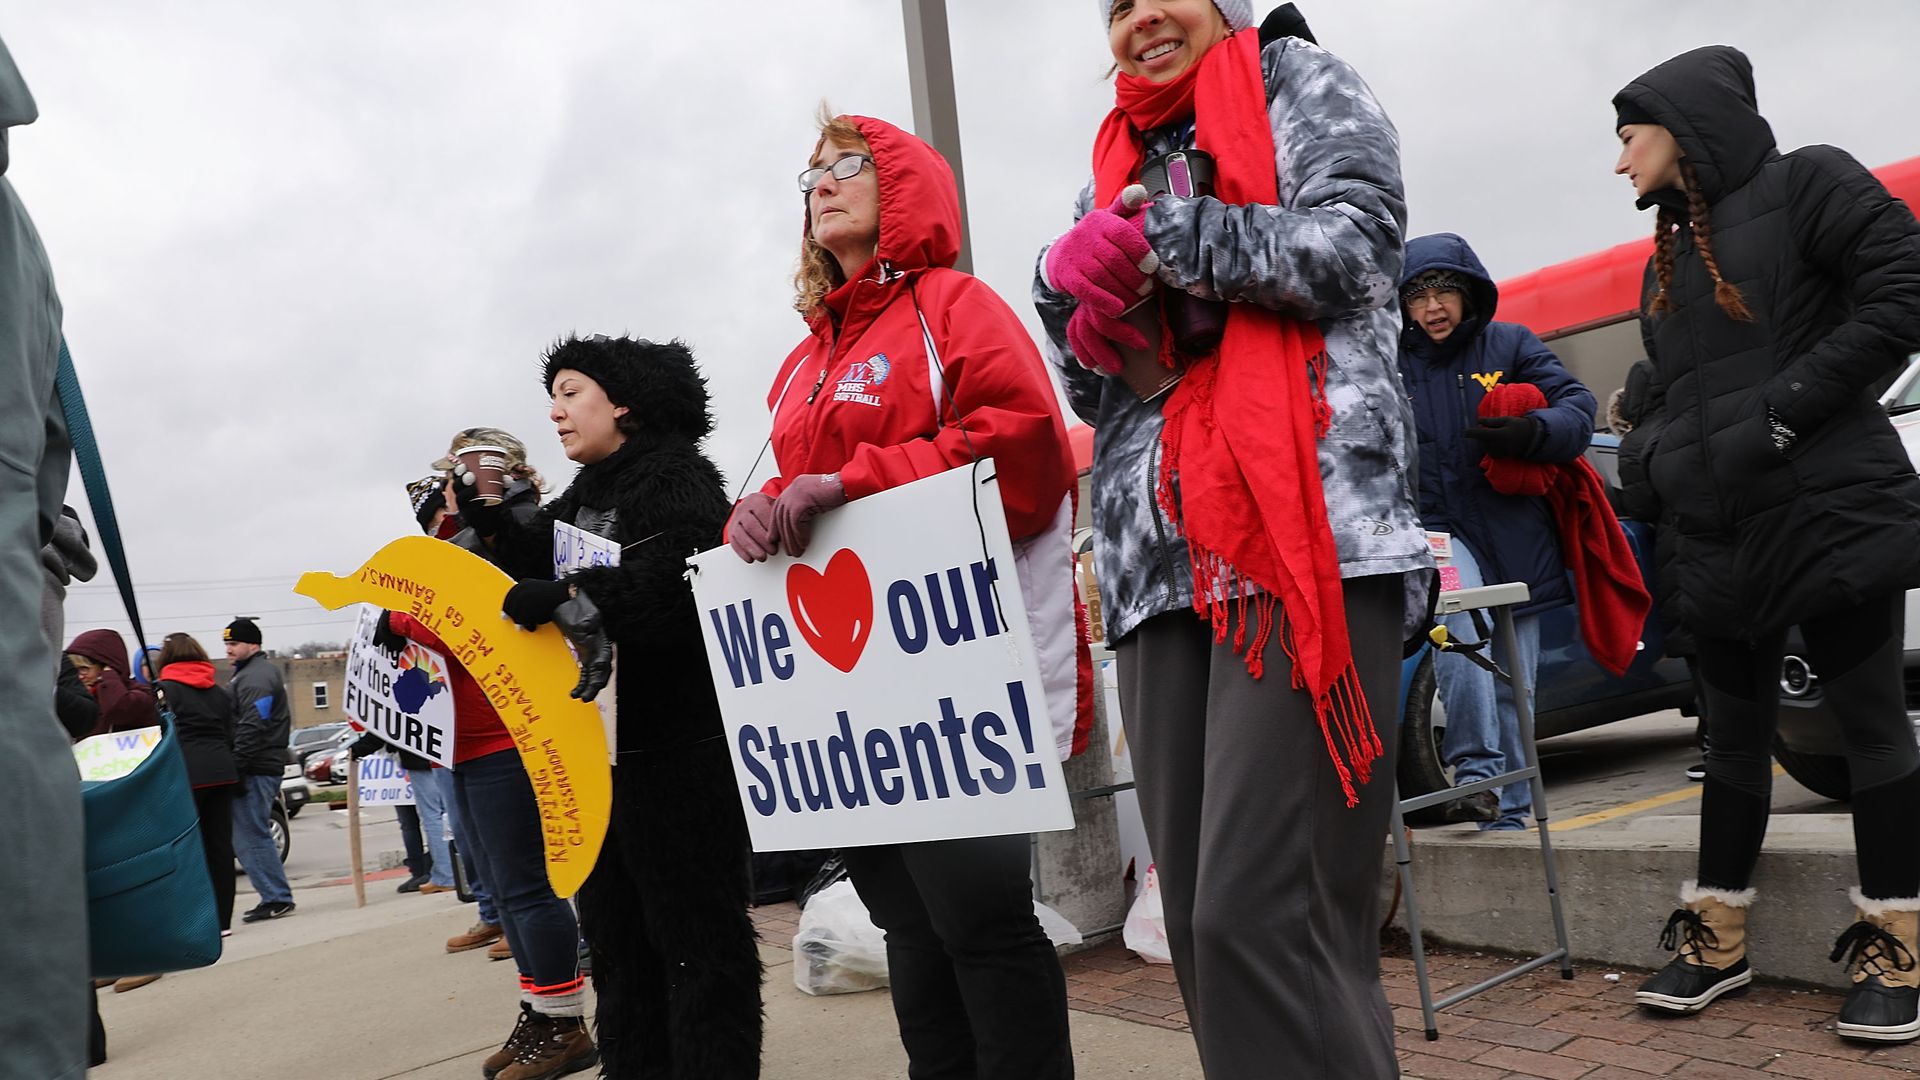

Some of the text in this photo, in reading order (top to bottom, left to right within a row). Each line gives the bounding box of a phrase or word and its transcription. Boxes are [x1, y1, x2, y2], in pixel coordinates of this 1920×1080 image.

[833, 392, 881, 406] SOFTBALL
[709, 598, 795, 689] We
[887, 558, 1000, 656] our
[360, 567, 584, 846] CLASSROOM MAKES ME GO BANANAS!
[368, 659, 390, 698] the
[115, 731, 159, 751] WV
[346, 680, 443, 760] FUTURE
[408, 600, 569, 863] KEEPING ME OUT OF THE
[738, 680, 1047, 817] Students!
[358, 786, 377, 801] For
[380, 787, 401, 801] our
